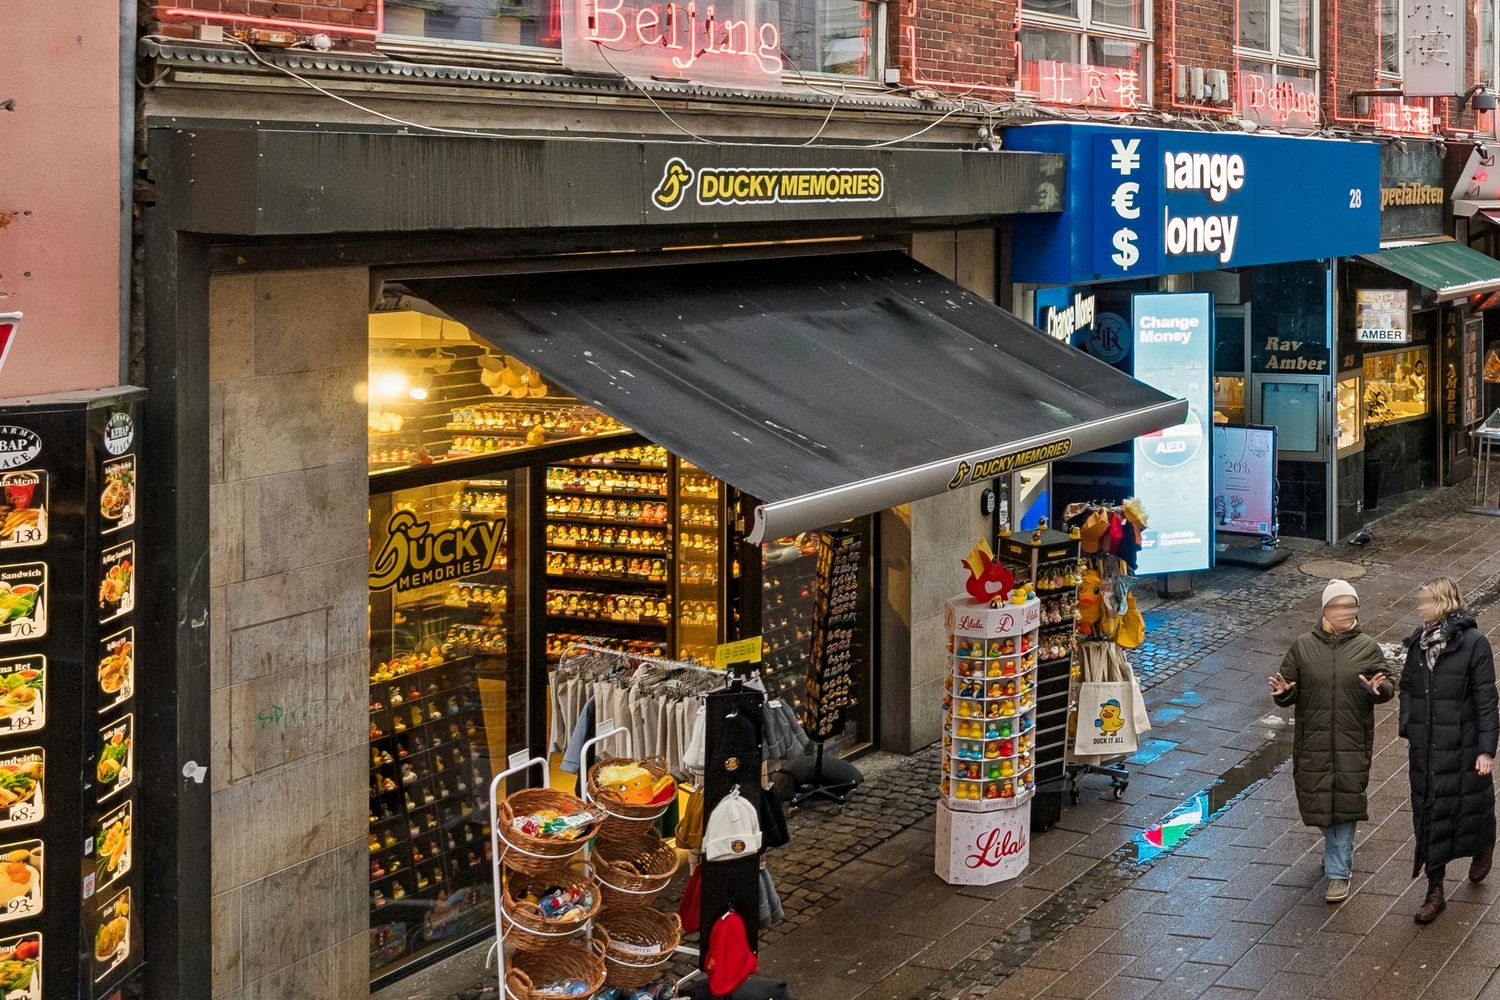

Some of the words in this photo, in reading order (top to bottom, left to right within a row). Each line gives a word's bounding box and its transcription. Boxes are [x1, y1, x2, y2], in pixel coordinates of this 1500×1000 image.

[1249, 74, 1317, 122] Beijing
[1111, 139, 1141, 175] ¥
[702, 175, 777, 198] DUCKY
[781, 174, 880, 197] MEMORIES
[1111, 182, 1141, 219] €
[1349, 189, 1362, 208] 28
[1164, 205, 1238, 263] oney
[1111, 228, 1139, 271] $
[1074, 292, 1096, 330] Money
[1139, 316, 1200, 329] Change
[1139, 330, 1192, 344] Money
[1361, 330, 1402, 340] AMBER
[1265, 337, 1303, 351] Rav
[1265, 354, 1327, 370] Amber
[1445, 363, 1458, 425] AMBER
[1156, 441, 1186, 453] AED
[3, 452, 31, 468] ACE
[973, 457, 1015, 480] DUCKY
[1014, 438, 1070, 467] MEMORIES
[1224, 461, 1251, 473] 20%
[13, 478, 40, 486] Menu
[1, 569, 42, 580] Sandwich
[400, 558, 481, 589] MEMORIES
[14, 662, 32, 672] Ret
[1093, 737, 1107, 745] DUCK
[1114, 736, 1124, 744] ALL
